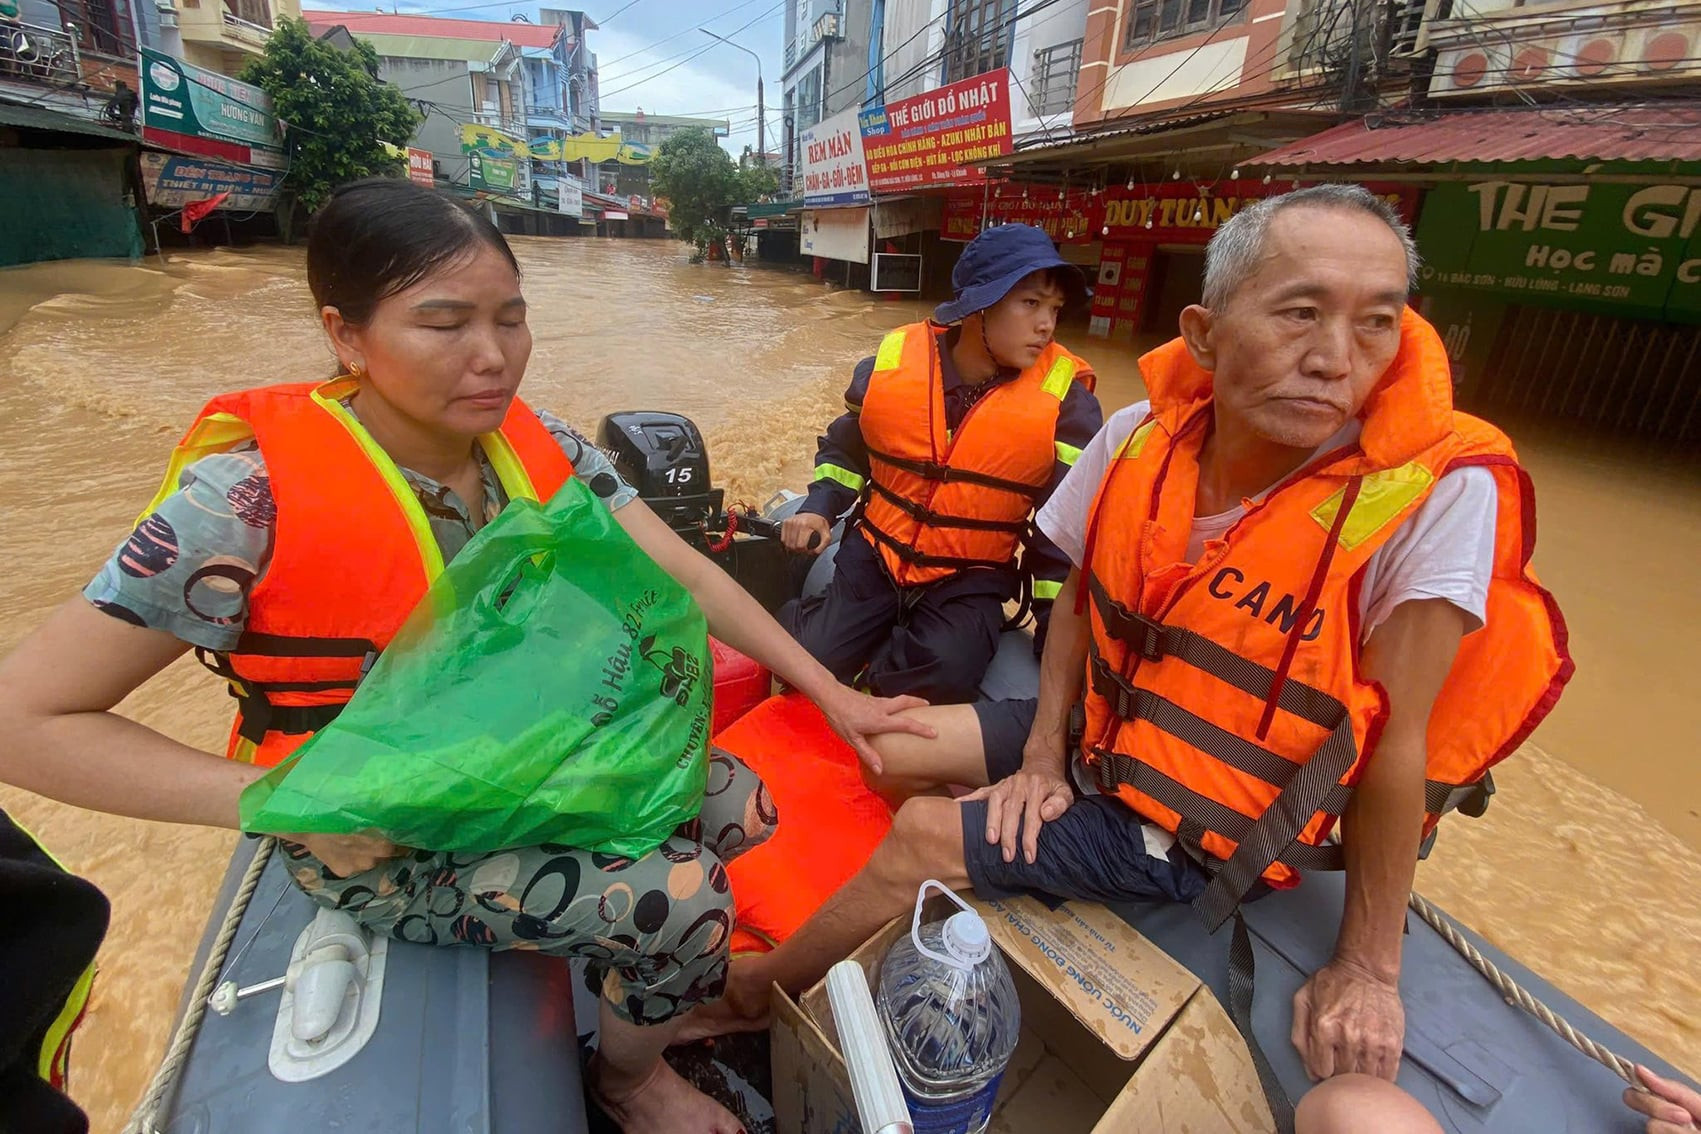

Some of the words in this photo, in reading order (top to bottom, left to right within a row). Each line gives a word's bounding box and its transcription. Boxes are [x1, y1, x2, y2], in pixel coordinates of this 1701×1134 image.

[889, 103, 909, 128] THẾ
[911, 98, 936, 123] GIỚI
[938, 89, 957, 116] ĐỒ
[959, 81, 998, 109] NHẬT
[828, 129, 852, 159] MÀN
[867, 127, 885, 137] Shop
[941, 130, 964, 147] AZUKI
[964, 124, 986, 143] NHẬT
[987, 118, 1006, 138] BẢN
[1104, 198, 1156, 227] DUY
[1608, 246, 1665, 277] mà
[665, 467, 693, 484] 15
[602, 643, 633, 691] Hậu
[622, 613, 641, 640] 82
[1004, 911, 1032, 937] CHAI
[1030, 935, 1067, 967] ĐÓNG
[1066, 966, 1102, 1000] UỐNG
[1102, 996, 1142, 1034] NƯỚC
